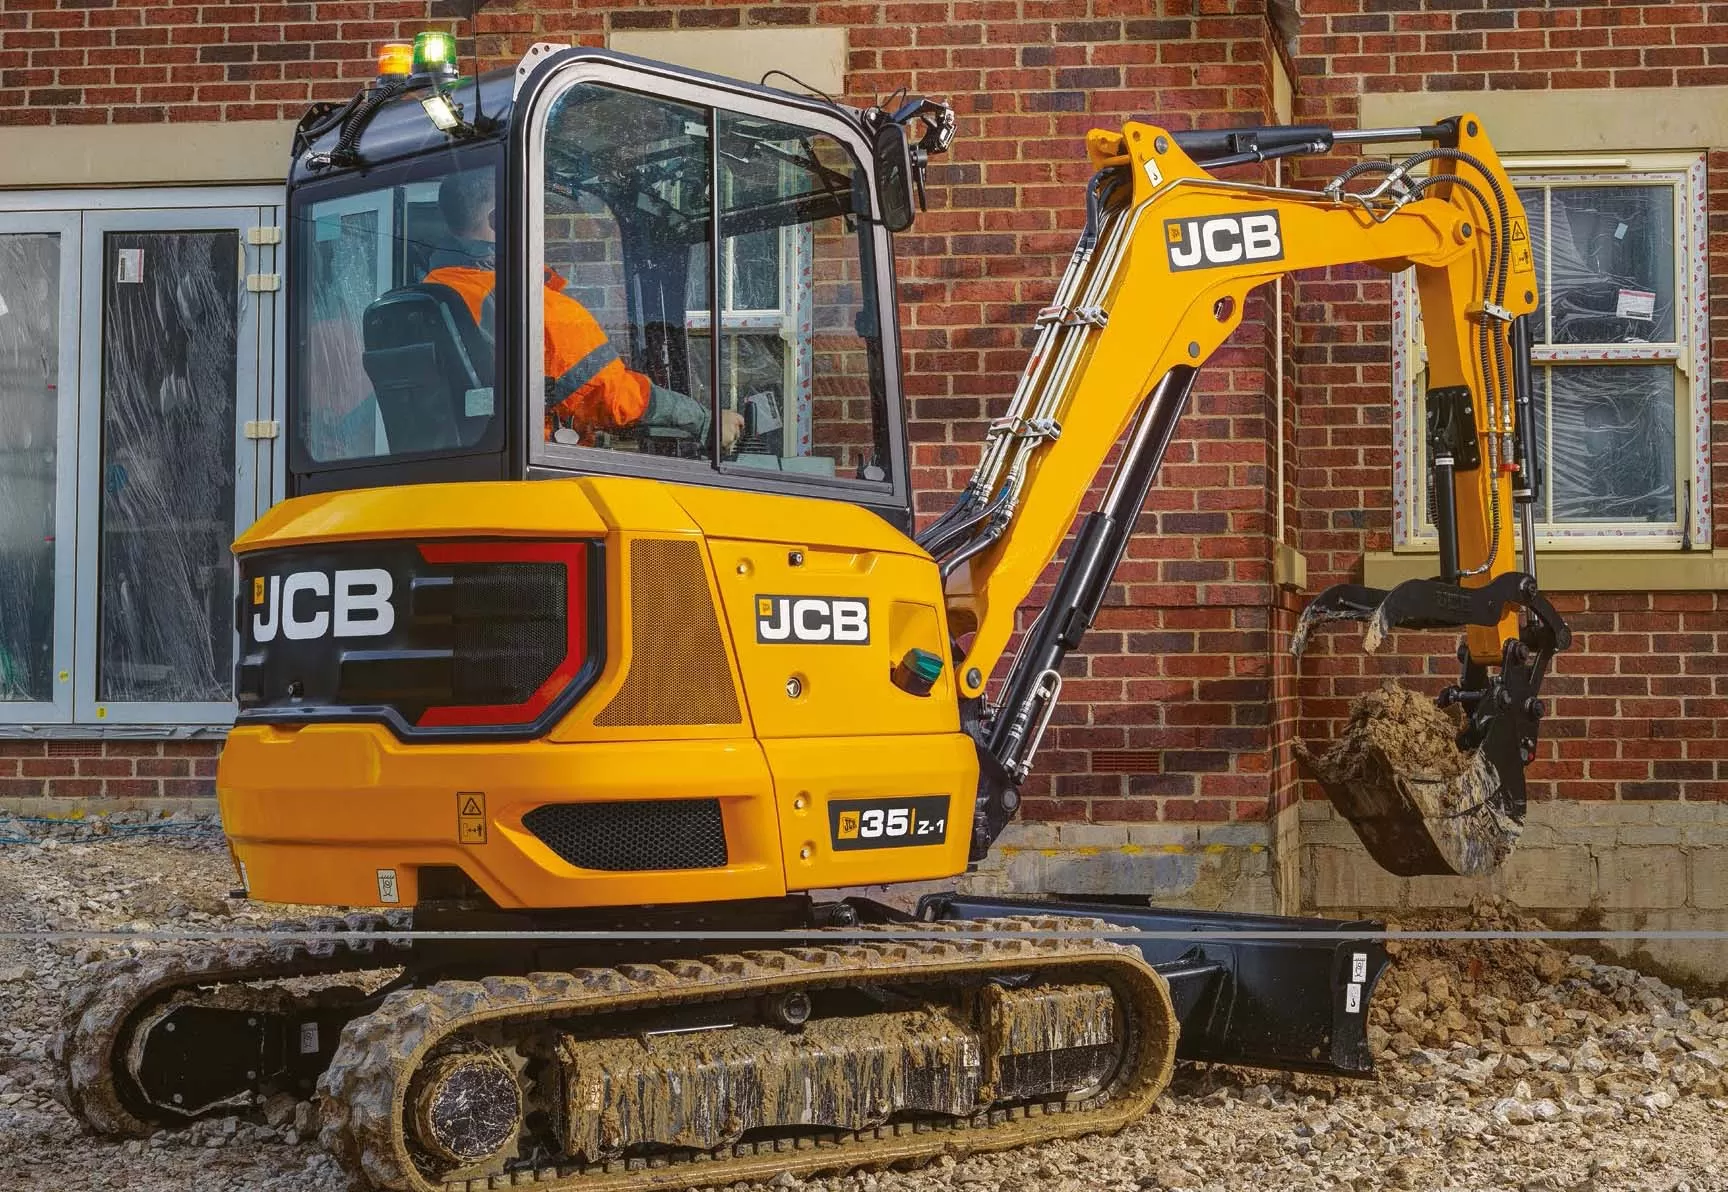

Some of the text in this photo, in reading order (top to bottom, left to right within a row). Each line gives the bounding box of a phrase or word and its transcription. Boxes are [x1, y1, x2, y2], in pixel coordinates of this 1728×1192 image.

[1171, 215, 1280, 267] JCB
[253, 568, 395, 642] JCB
[760, 599, 868, 640] JCB
[861, 809, 909, 837] 35
[917, 819, 945, 835] Z-1
